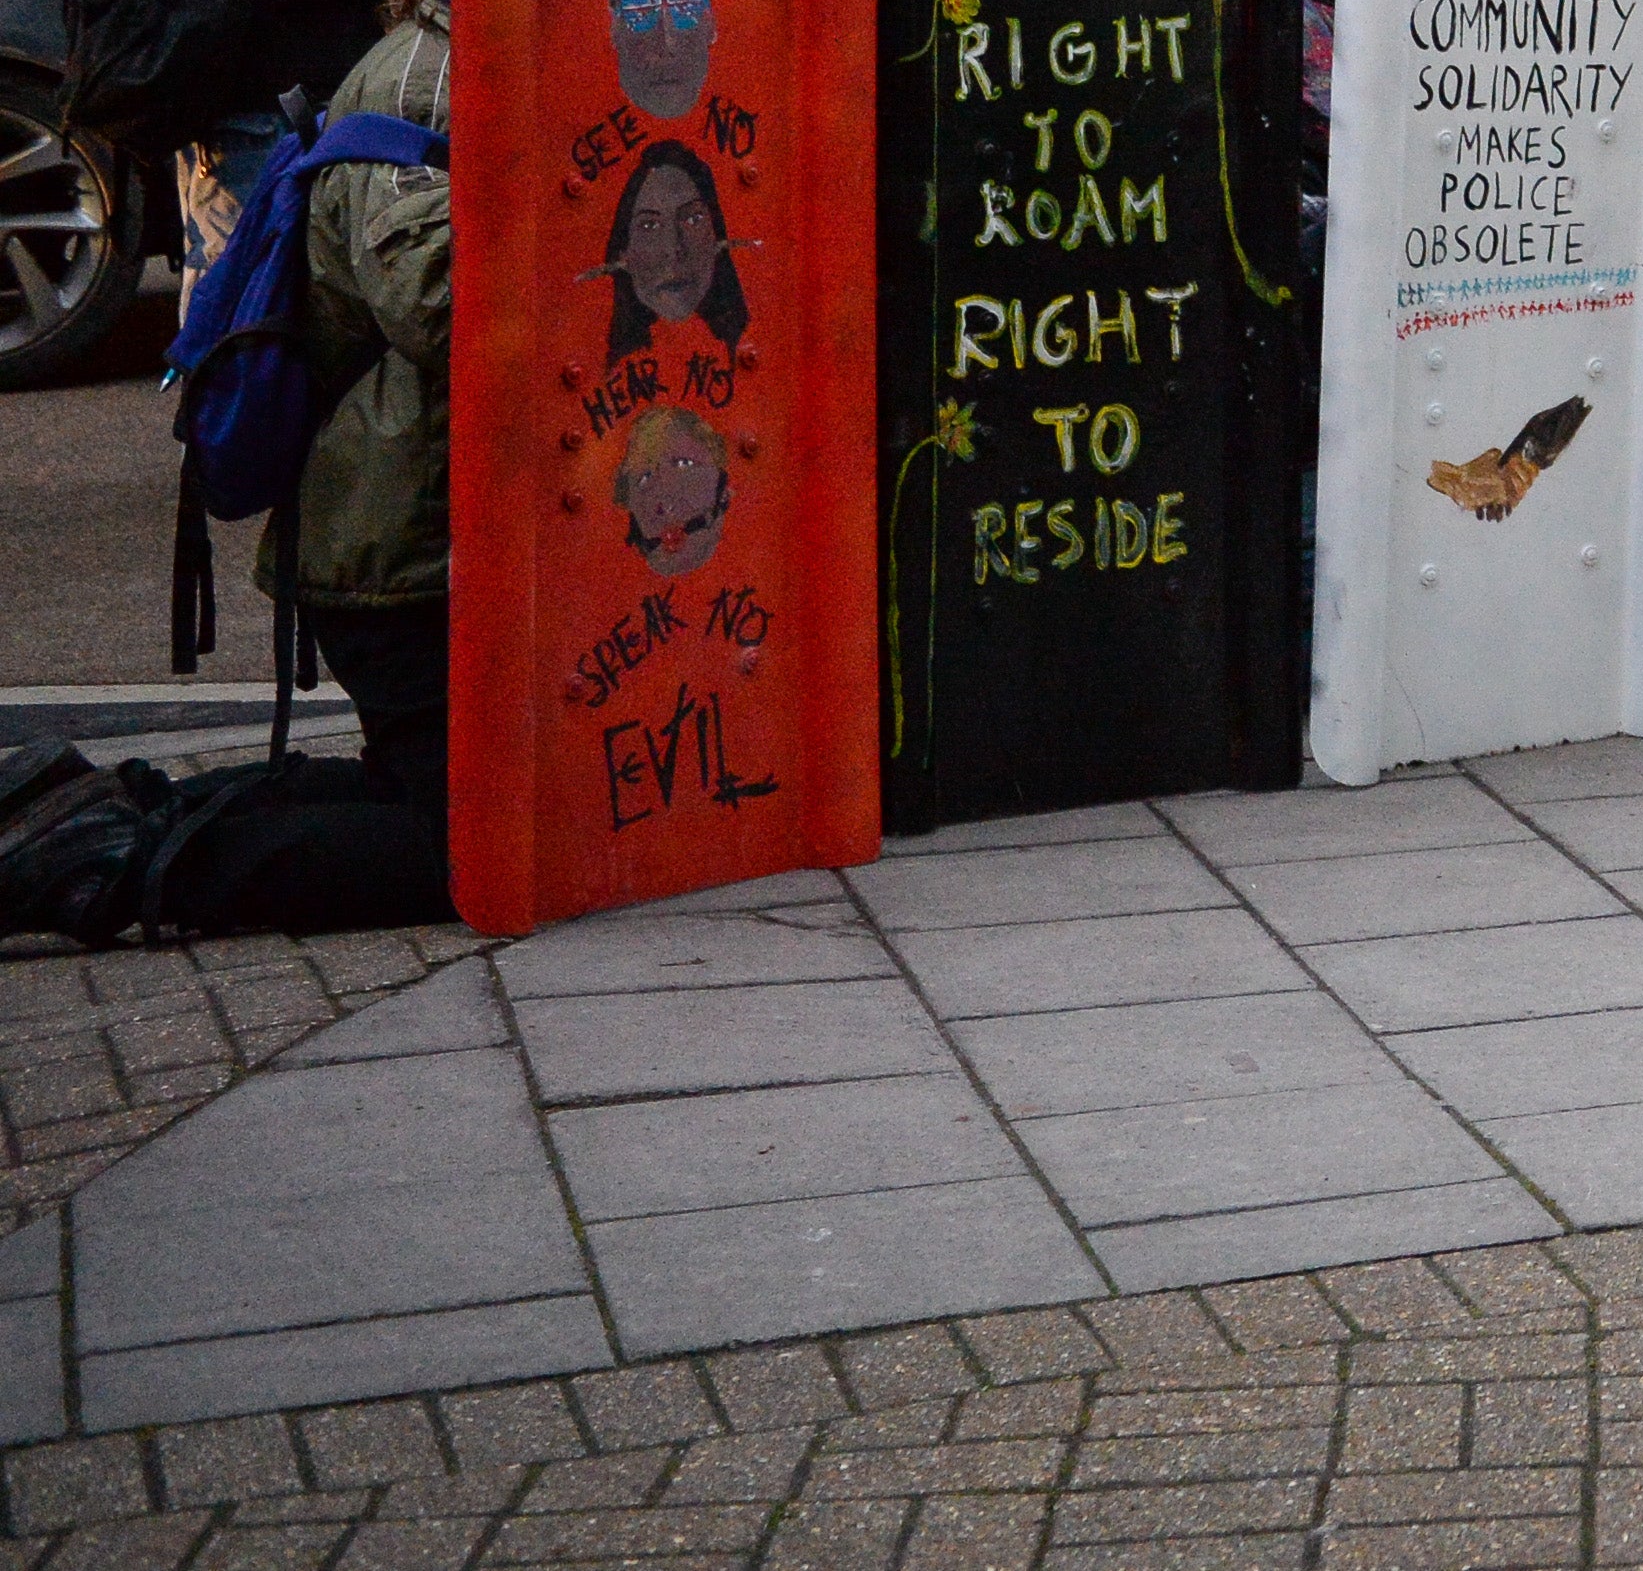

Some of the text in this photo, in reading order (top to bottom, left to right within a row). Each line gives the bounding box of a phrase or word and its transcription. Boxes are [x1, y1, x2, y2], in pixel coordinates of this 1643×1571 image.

[955, 13, 1191, 101] RIGHT
[1414, 62, 1633, 118] SOLIDARITY
[571, 97, 757, 181] SEE NO
[1024, 109, 1112, 172] TO
[1457, 124, 1566, 169] MAKES
[975, 174, 1166, 250] ROAM
[1441, 171, 1573, 216] POLICE
[1405, 222, 1585, 268] OBSOLETE
[947, 281, 1199, 379] RIGHT
[583, 350, 734, 438] HEAR NO
[1033, 403, 1140, 475] TO
[972, 492, 1188, 585] RESIDE
[578, 585, 773, 709] SPEAK NO
[603, 683, 779, 832] EVIL
